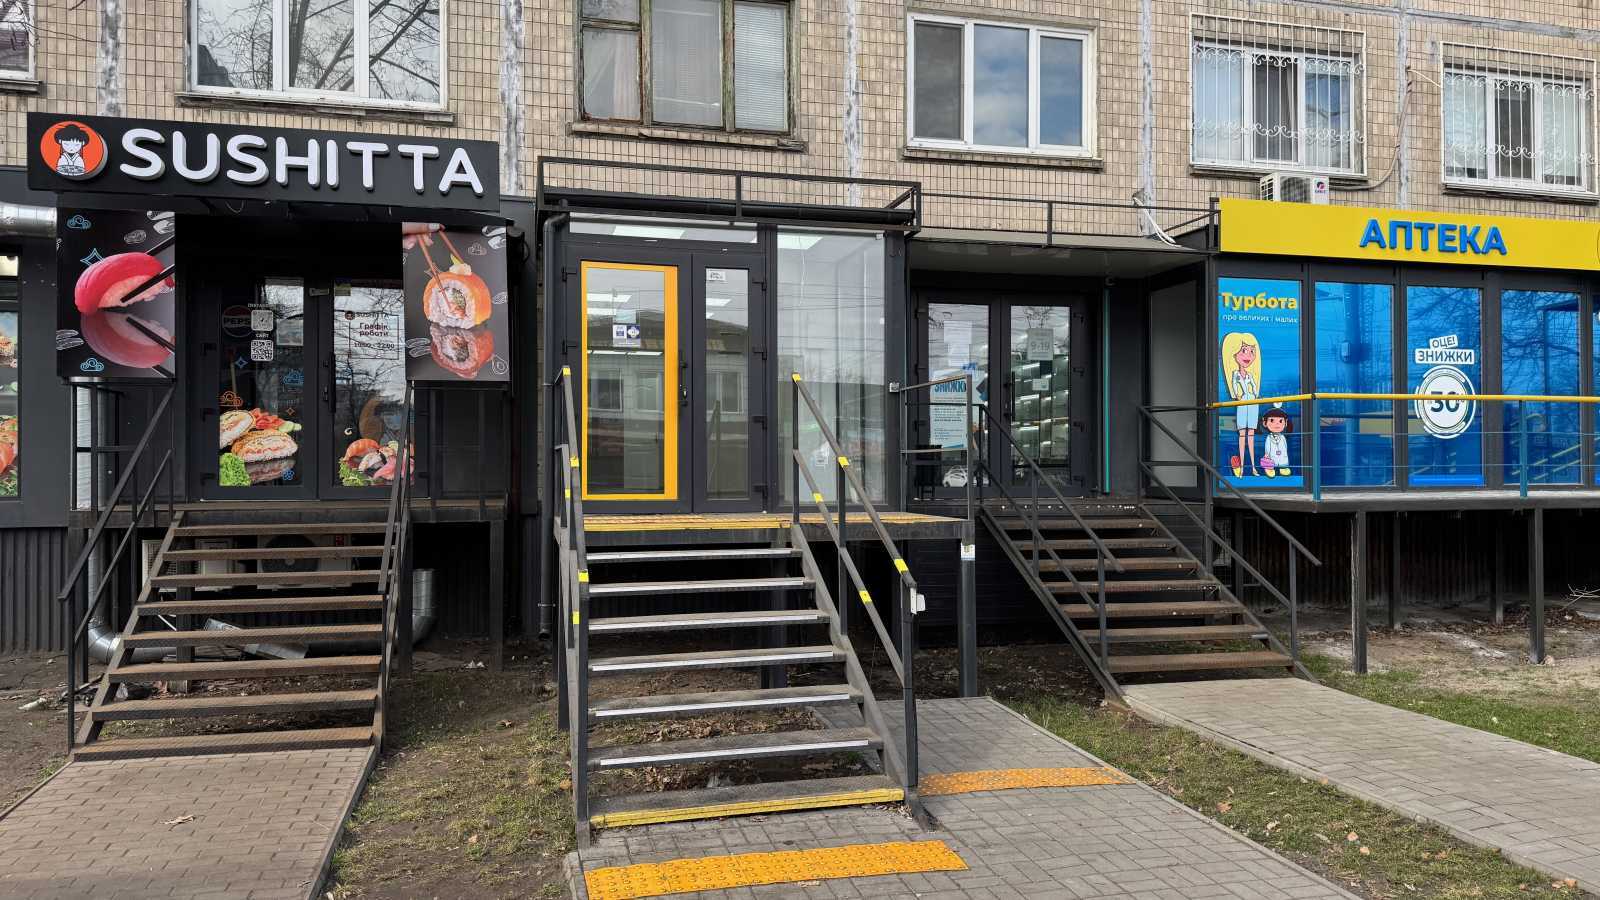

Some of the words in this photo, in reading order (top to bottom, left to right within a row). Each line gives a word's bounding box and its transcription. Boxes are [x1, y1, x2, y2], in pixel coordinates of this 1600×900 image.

[119, 128, 485, 197] SUSHITTA
[1359, 219, 1507, 256] АПТЕКА
[1221, 292, 1298, 311] Турбота
[223, 316, 251, 327] PEPS
[1238, 314, 1269, 322] великих
[1275, 316, 1298, 324] малих
[359, 322, 389, 331] Графік
[1431, 336, 1456, 348] ОЦЕ!
[1417, 351, 1473, 362] ЗНИЖКИ
